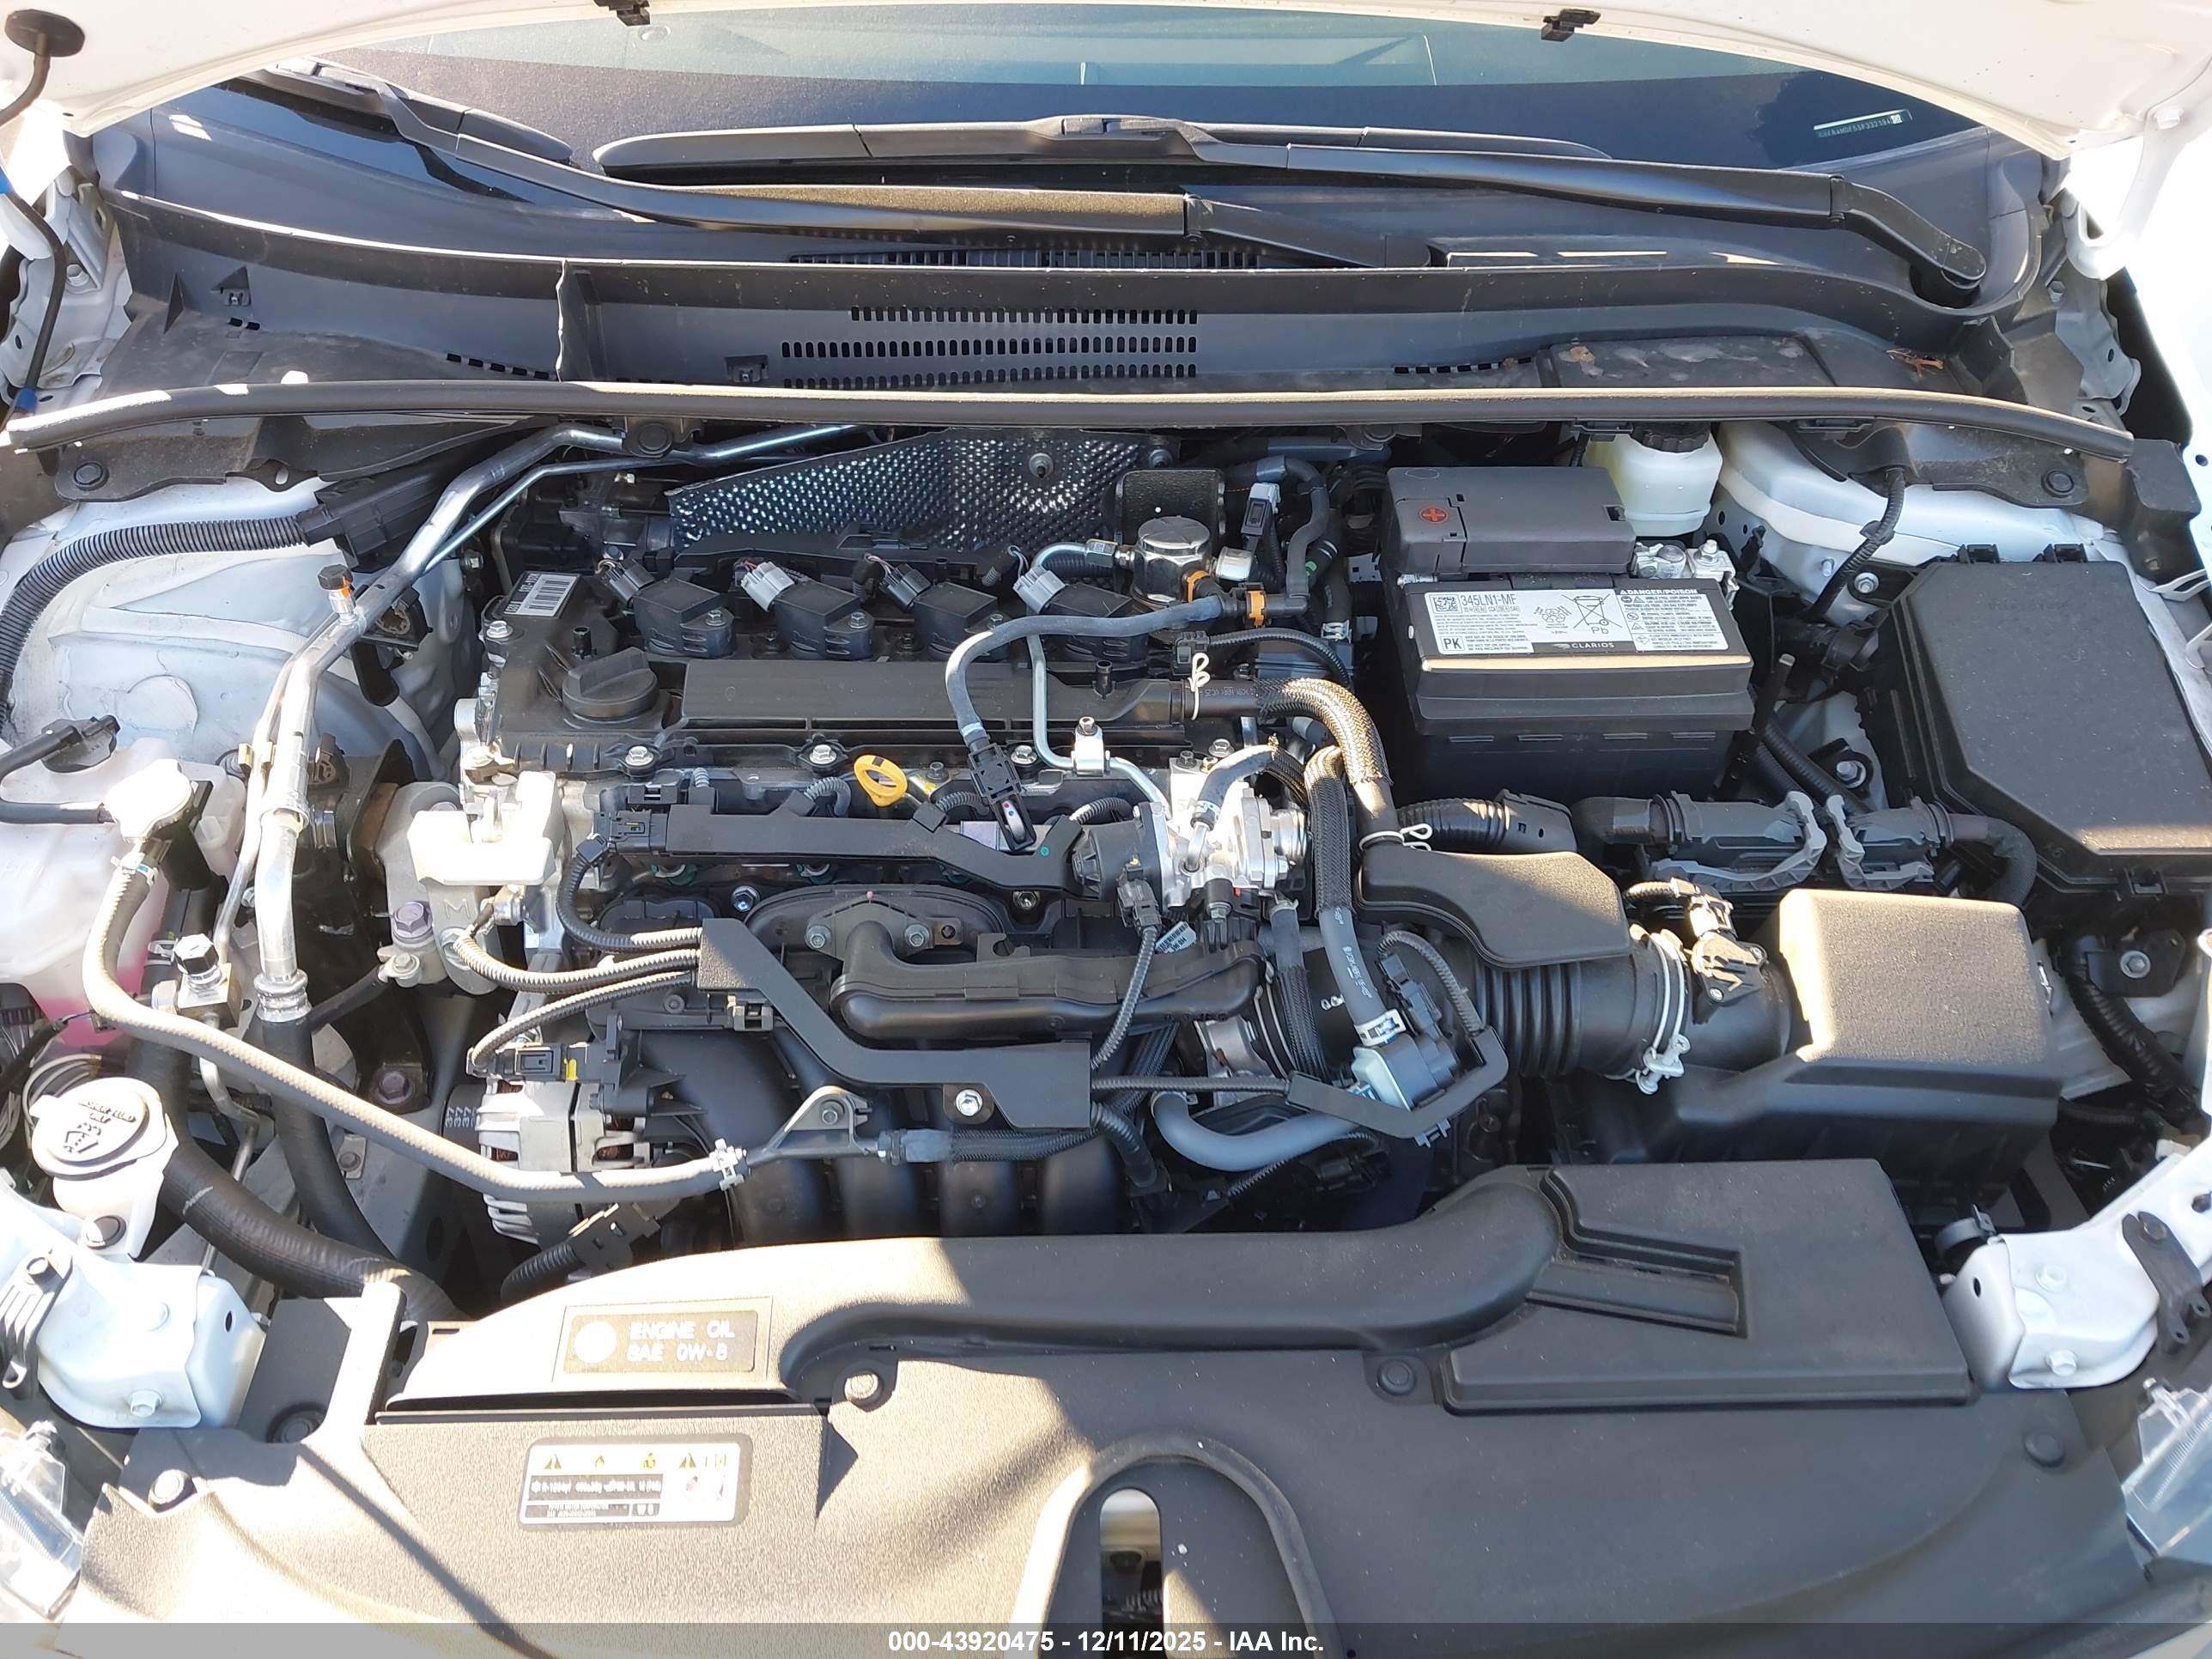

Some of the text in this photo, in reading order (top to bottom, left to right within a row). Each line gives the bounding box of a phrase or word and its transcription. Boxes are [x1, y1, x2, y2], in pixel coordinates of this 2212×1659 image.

[1461, 594, 1517, 605] 345LN1-MF
[1591, 626, 1609, 635] Pb
[1443, 638, 1462, 649] PK
[630, 1318, 736, 1340] ENGINE OIL
[627, 1342, 665, 1363] SAE
